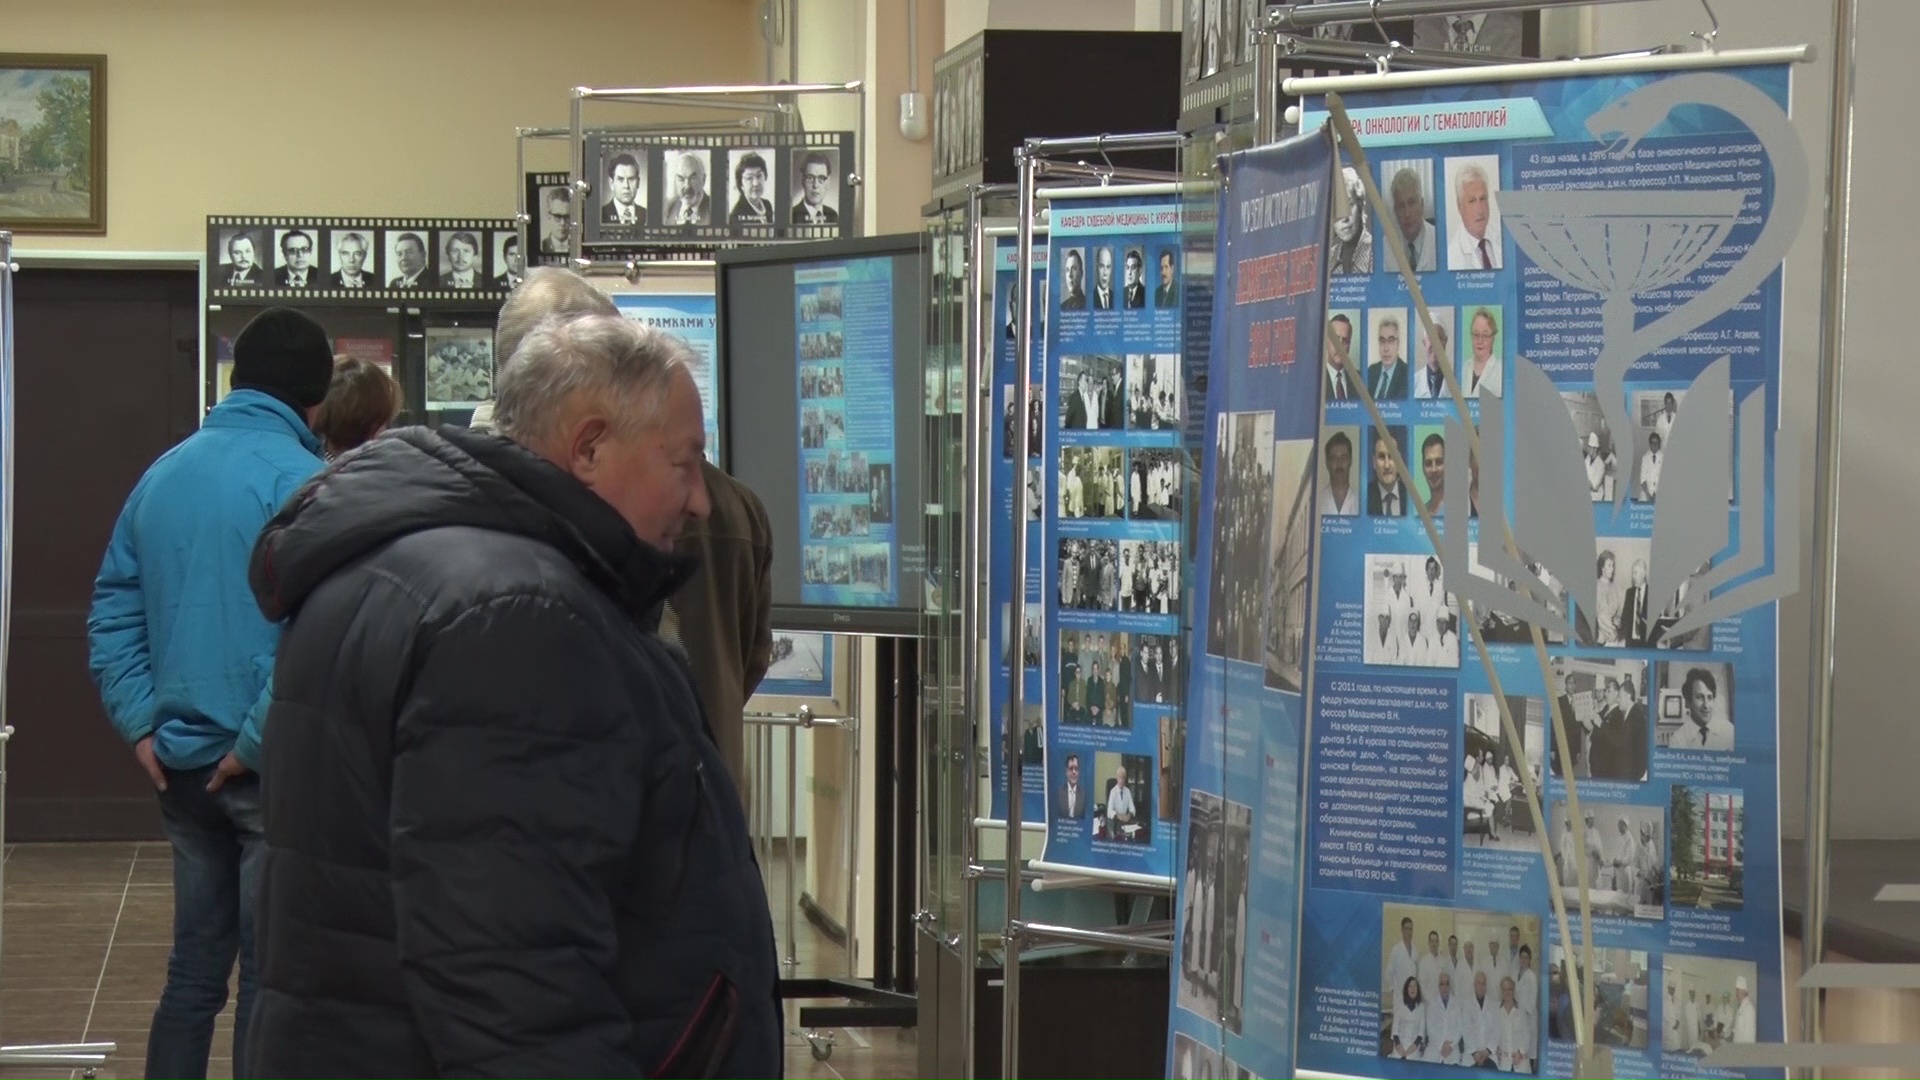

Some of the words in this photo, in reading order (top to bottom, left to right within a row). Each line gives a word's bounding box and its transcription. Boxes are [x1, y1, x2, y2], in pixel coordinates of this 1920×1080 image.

[1365, 116, 1420, 136] ОНКОЛОГИИ
[1424, 116, 1429, 131] С
[1433, 107, 1507, 130] ГЕМАТОЛОГИЕЙ
[1530, 154, 1539, 164] 43
[1541, 155, 1556, 164] года
[1638, 148, 1654, 158] базе
[1656, 146, 1716, 157] онкологического
[1718, 144, 1762, 154] диспансера
[1520, 168, 1568, 179] организована
[1568, 167, 1598, 176] кафедра
[1599, 166, 1634, 174] онкологии
[1636, 163, 1684, 173] Ярославского
[1684, 160, 1737, 170] Медицинского
[1738, 158, 1762, 166] Инсти-
[1538, 181, 1564, 191] которой
[1628, 178, 1666, 188] профессор
[1737, 172, 1761, 182] Препо-
[1264, 186, 1299, 228] ИСТОРИИ
[1060, 216, 1085, 228] КАФЕДРА
[1086, 212, 1115, 228] СУДЕБНОЙ
[1116, 212, 1149, 226] МЕДИЦИНЫ
[1150, 213, 1154, 224] С
[1156, 212, 1179, 224] КУРСОМ
[1524, 280, 1560, 288] низатором
[1525, 293, 1540, 302] ский
[1542, 292, 1560, 302] Марк
[1562, 292, 1596, 302] Петрович,
[648, 318, 704, 328] РАМКАМИ
[1526, 320, 1568, 330] клинической
[1534, 334, 1540, 344] В
[1542, 334, 1560, 343] 1996
[1562, 336, 1576, 344] году
[1526, 347, 1570, 358] заслуженный
[1570, 348, 1587, 358] врач
[1588, 346, 1600, 356] РФ
[1688, 344, 1742, 354] межобластного
[1331, 682, 1336, 690] С
[1338, 682, 1356, 692] 2011
[1356, 684, 1372, 693] года,
[1382, 685, 1416, 694] настоящее
[1320, 696, 1342, 706] федру
[1343, 697, 1376, 706] онкологии
[1377, 699, 1414, 708] возглавляет
[1320, 709, 1346, 718] фессор
[1348, 709, 1386, 720] Малашенко
[1386, 711, 1400, 720] В.Н.
[1330, 722, 1340, 730] На
[1342, 723, 1369, 733] кафедре
[1370, 724, 1406, 734] проводится
[1407, 725, 1436, 736] обучение
[1320, 736, 1344, 744] дентов
[1346, 736, 1352, 744] 5
[1358, 736, 1364, 745] 6
[1364, 738, 1386, 747] курсов
[1388, 738, 1396, 746] по
[1397, 740, 1448, 750] специальностям
[1320, 762, 1349, 770] цинская
[1400, 767, 1436, 776] постоянной
[1364, 778, 1398, 787] подготовка
[1400, 780, 1421, 790] кадров
[1422, 781, 1448, 790] высшей
[1320, 788, 1368, 798] квалификации
[1331, 803, 1384, 814] дополнительные
[1386, 806, 1448, 818] профессиональные
[1320, 813, 1378, 826] образовательные
[1380, 831, 1404, 840] базами
[1406, 834, 1434, 844] кафедры
[1320, 842, 1344, 850] ляются
[1346, 842, 1362, 852] ГБУЗ
[1364, 843, 1374, 852] ЯО
[1320, 855, 1350, 864] гическая
[1390, 860, 1448, 872] гематологическое
[1320, 868, 1354, 877] отделения
[1354, 868, 1370, 879] ГБУЗ
[1370, 870, 1380, 879] ЯО
